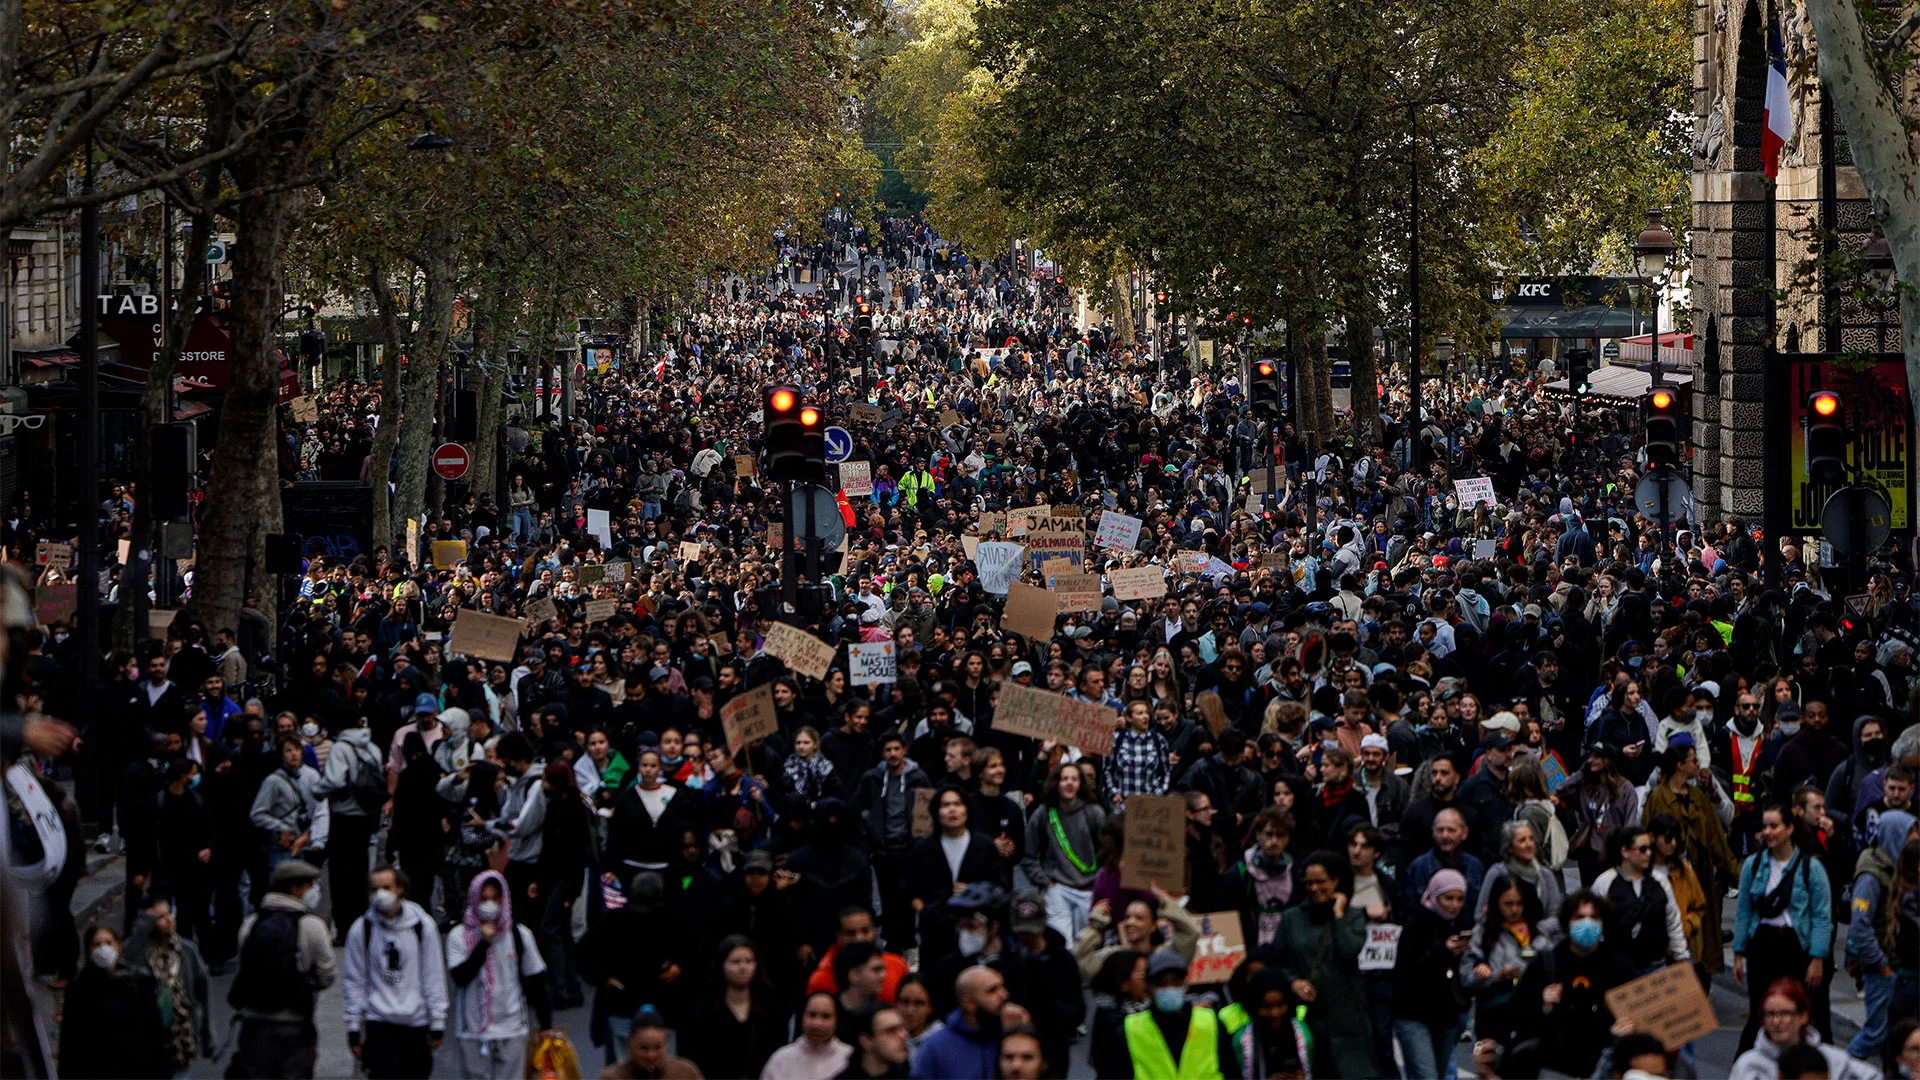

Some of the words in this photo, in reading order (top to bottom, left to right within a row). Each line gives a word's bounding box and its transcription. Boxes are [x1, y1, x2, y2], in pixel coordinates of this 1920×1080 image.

[1518, 284, 1550, 296] KFC
[97, 295, 202, 314] TAB
[153, 352, 225, 361] DGSTORE
